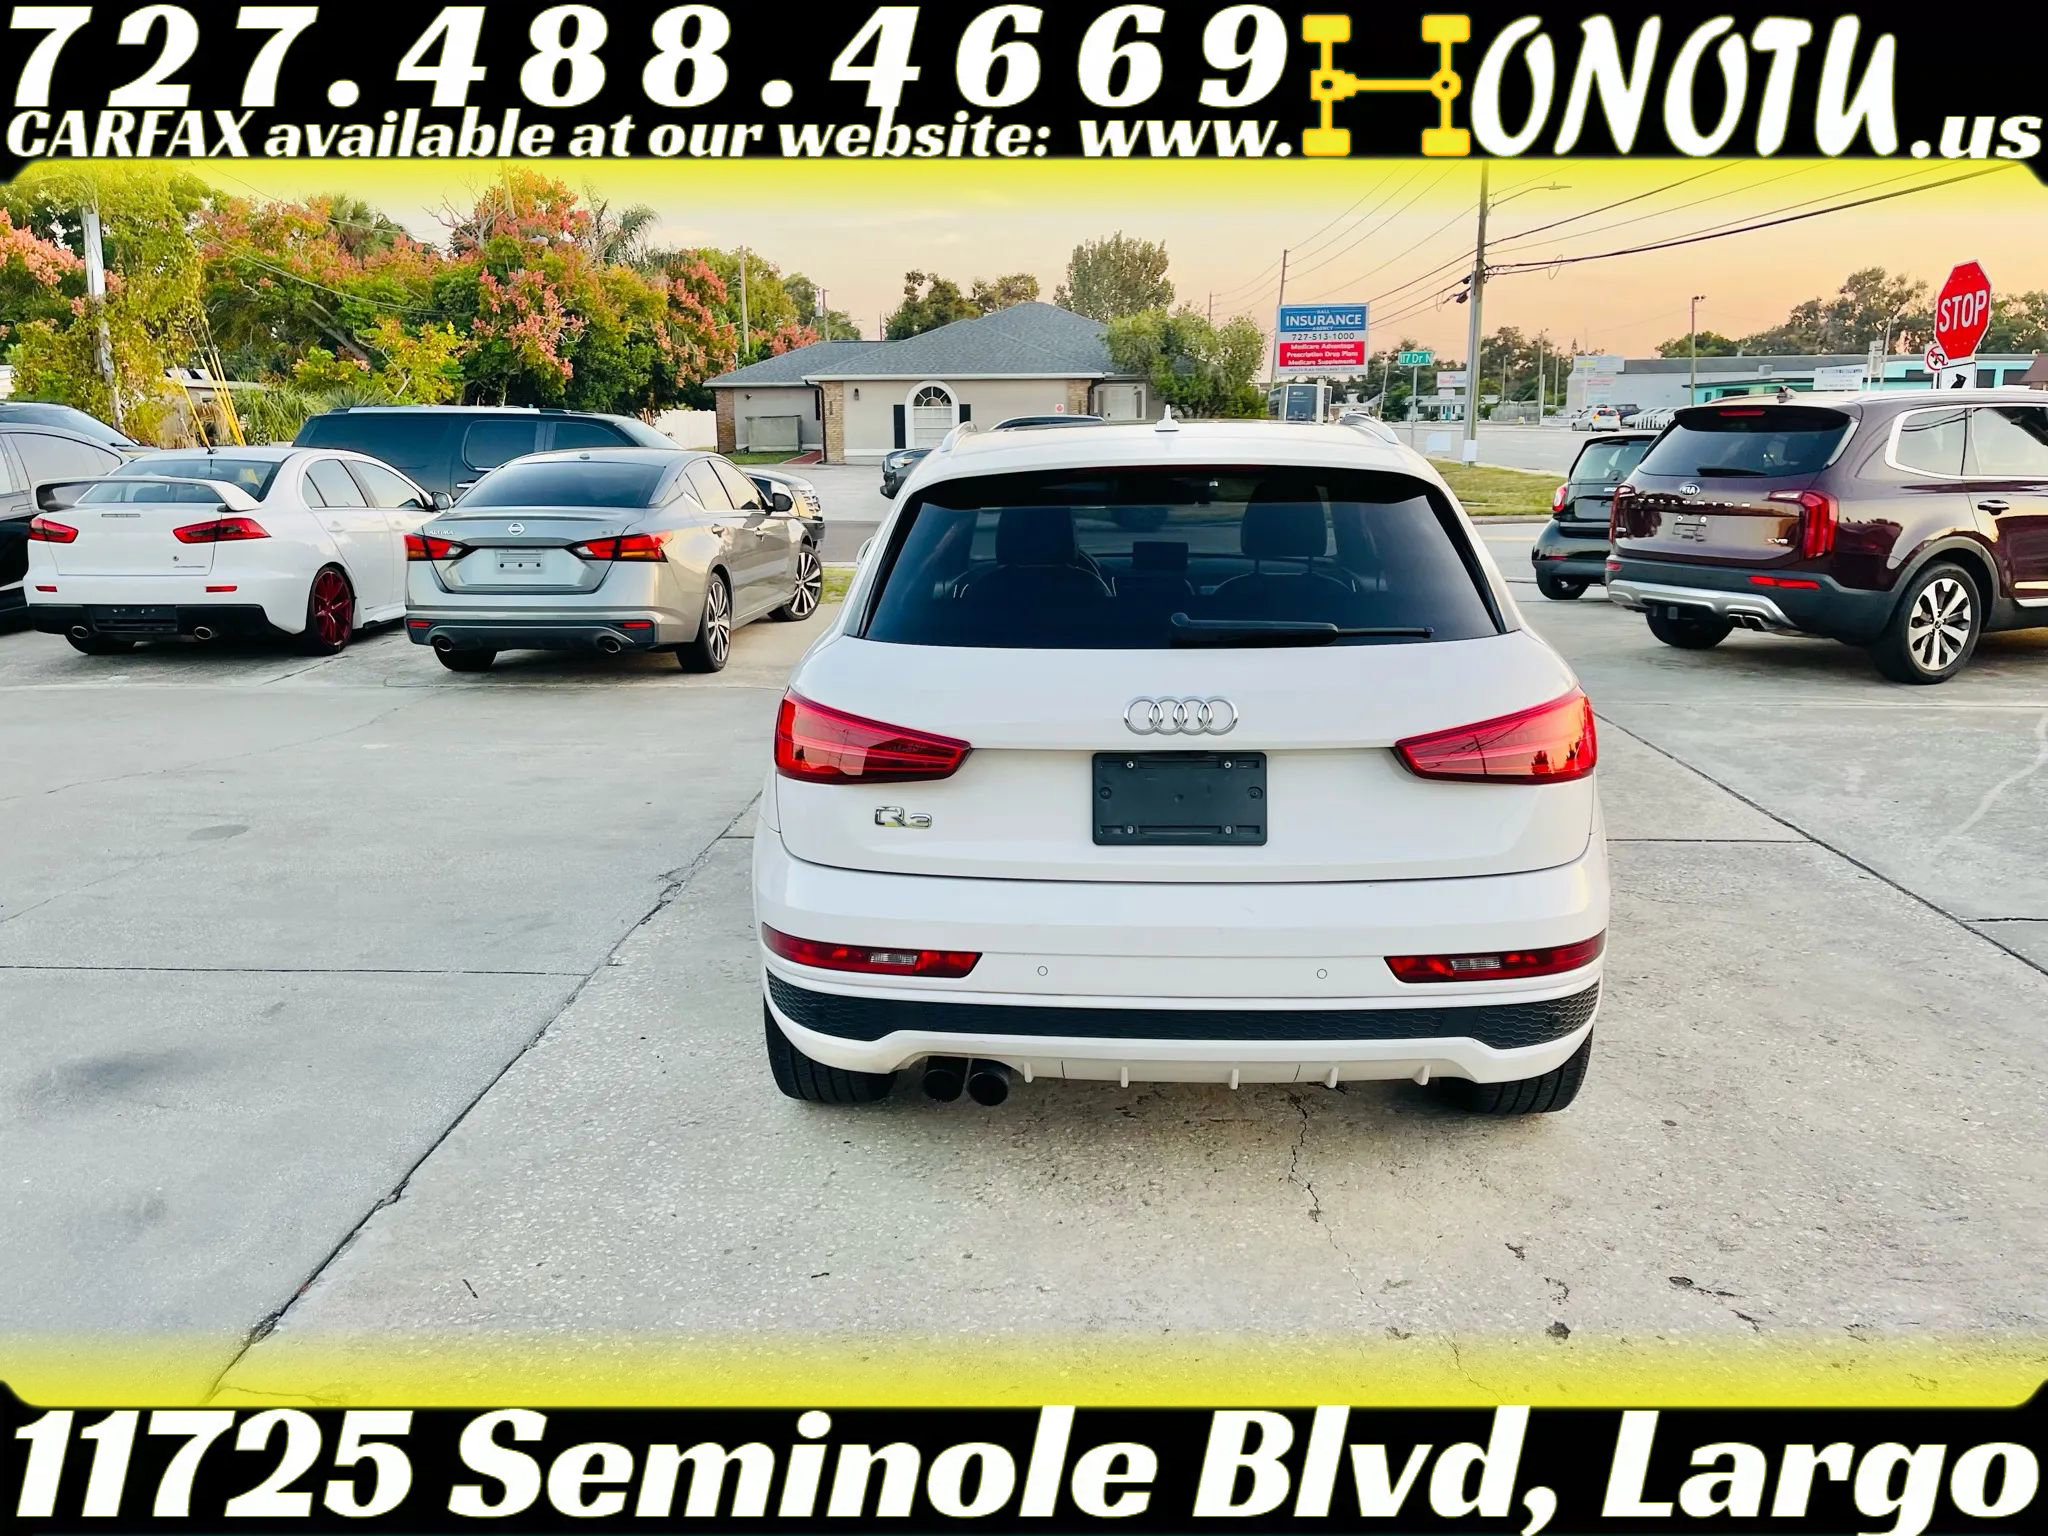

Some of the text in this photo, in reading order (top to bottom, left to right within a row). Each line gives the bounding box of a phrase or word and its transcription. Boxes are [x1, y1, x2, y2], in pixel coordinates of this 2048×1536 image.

[1939, 289, 1987, 333] STOP
[1286, 314, 1363, 327] INSURANCE
[1292, 332, 1356, 341] 727-513-1000
[1412, 353, 1423, 364] Dr
[1425, 353, 1433, 364] N
[1681, 486, 1698, 495] KIA
[875, 806, 932, 829] Q3
